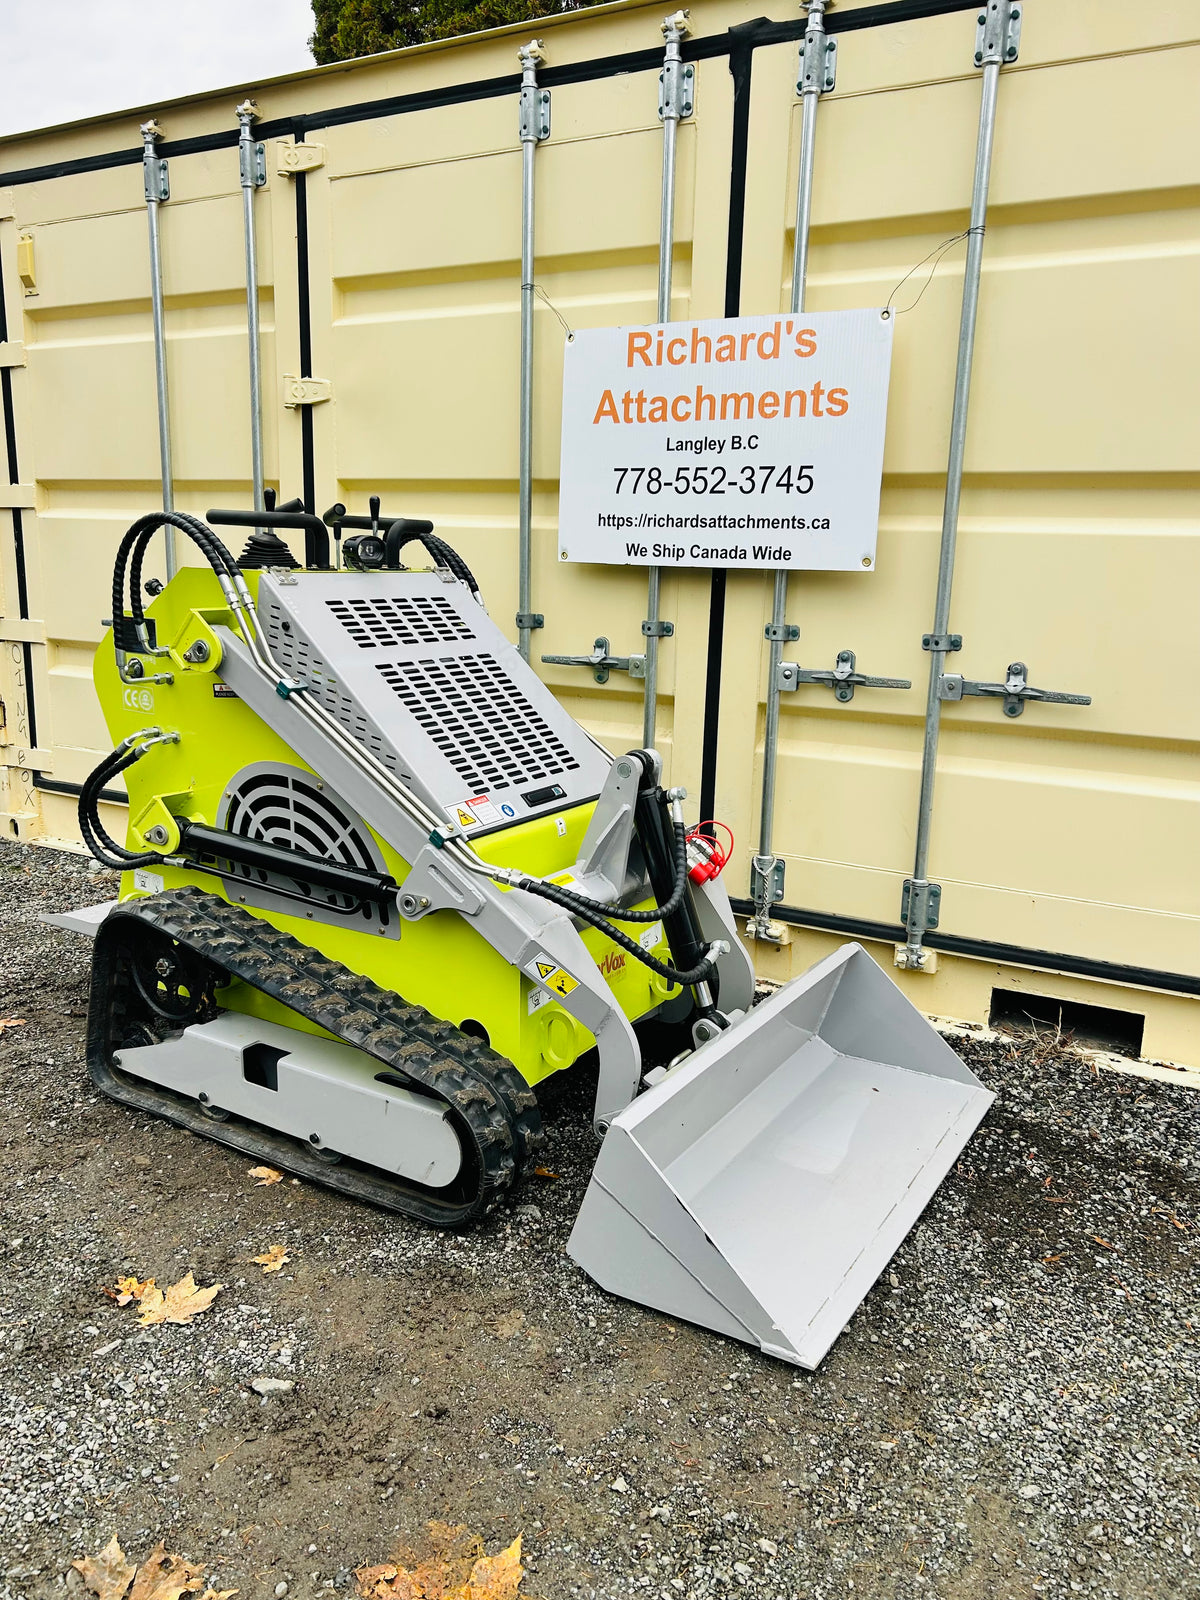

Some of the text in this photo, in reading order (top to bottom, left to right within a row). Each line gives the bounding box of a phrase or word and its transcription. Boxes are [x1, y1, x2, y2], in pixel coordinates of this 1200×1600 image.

[626, 320, 818, 368] Richard's
[592, 380, 849, 425] Attachments
[666, 434, 759, 454] Langley B.C
[613, 464, 815, 495] 778-552-3745
[597, 512, 831, 530] https://richardsattachments.ca
[625, 542, 792, 561] We Ship Canada Wide
[597, 951, 626, 976] rVox
